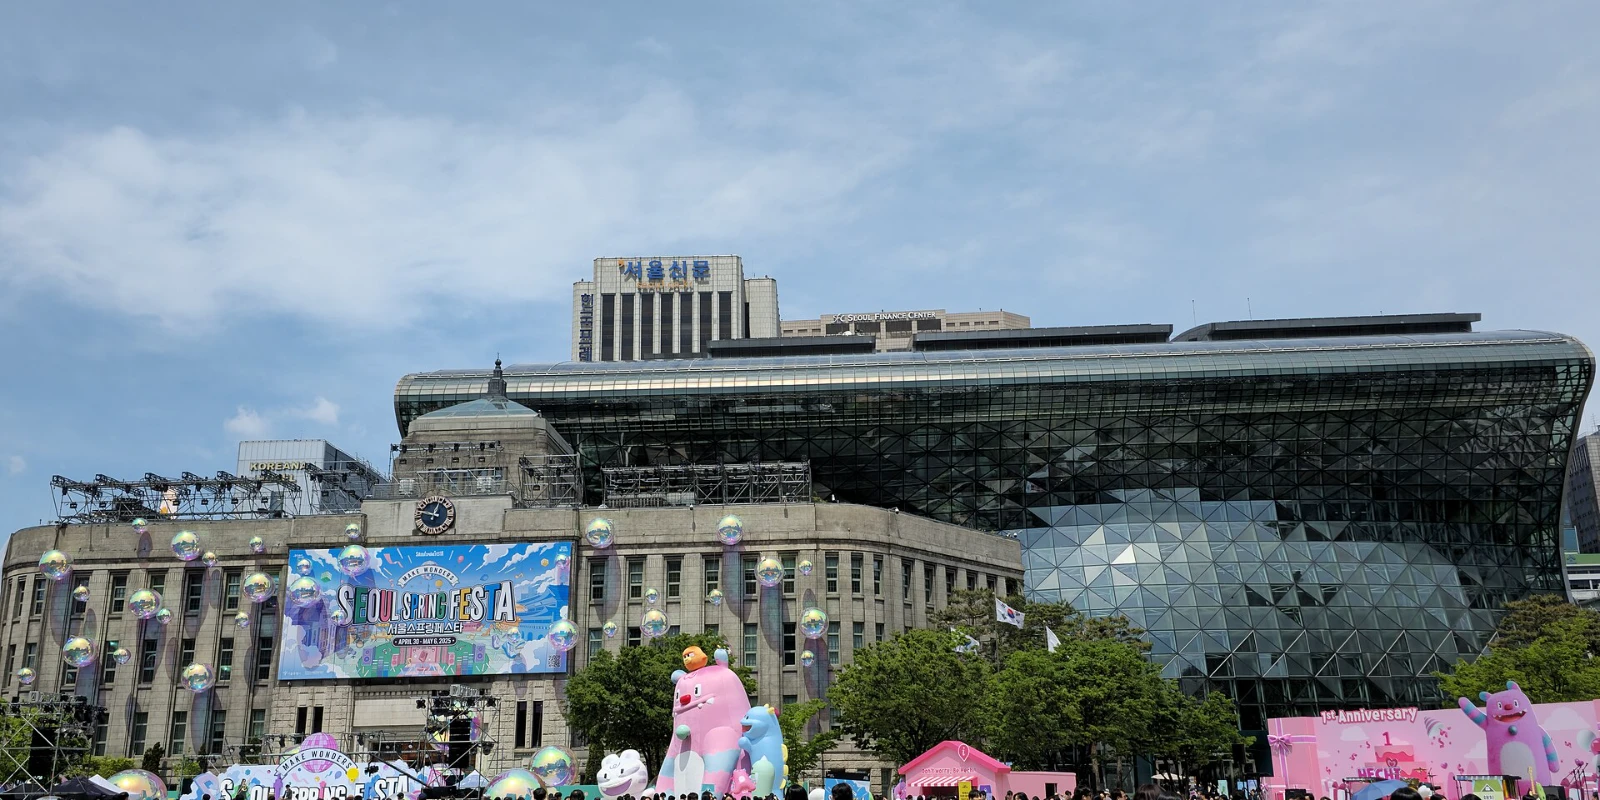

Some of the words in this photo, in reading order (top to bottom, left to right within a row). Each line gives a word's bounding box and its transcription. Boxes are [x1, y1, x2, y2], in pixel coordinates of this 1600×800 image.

[623, 260, 711, 279] 서울신문
[250, 462, 307, 471] KOREANA
[402, 568, 420, 582] MAKE
[423, 567, 455, 580] WONDERS
[338, 585, 400, 625] SEOUL
[402, 591, 448, 621] SPRING
[450, 580, 517, 622] FESTA
[387, 622, 463, 635] 서울스프링페스타
[1320, 709, 1338, 724] 1st
[1338, 705, 1418, 724] Anniversary
[282, 752, 306, 771] MAKE
[311, 750, 352, 769] WONDERS
